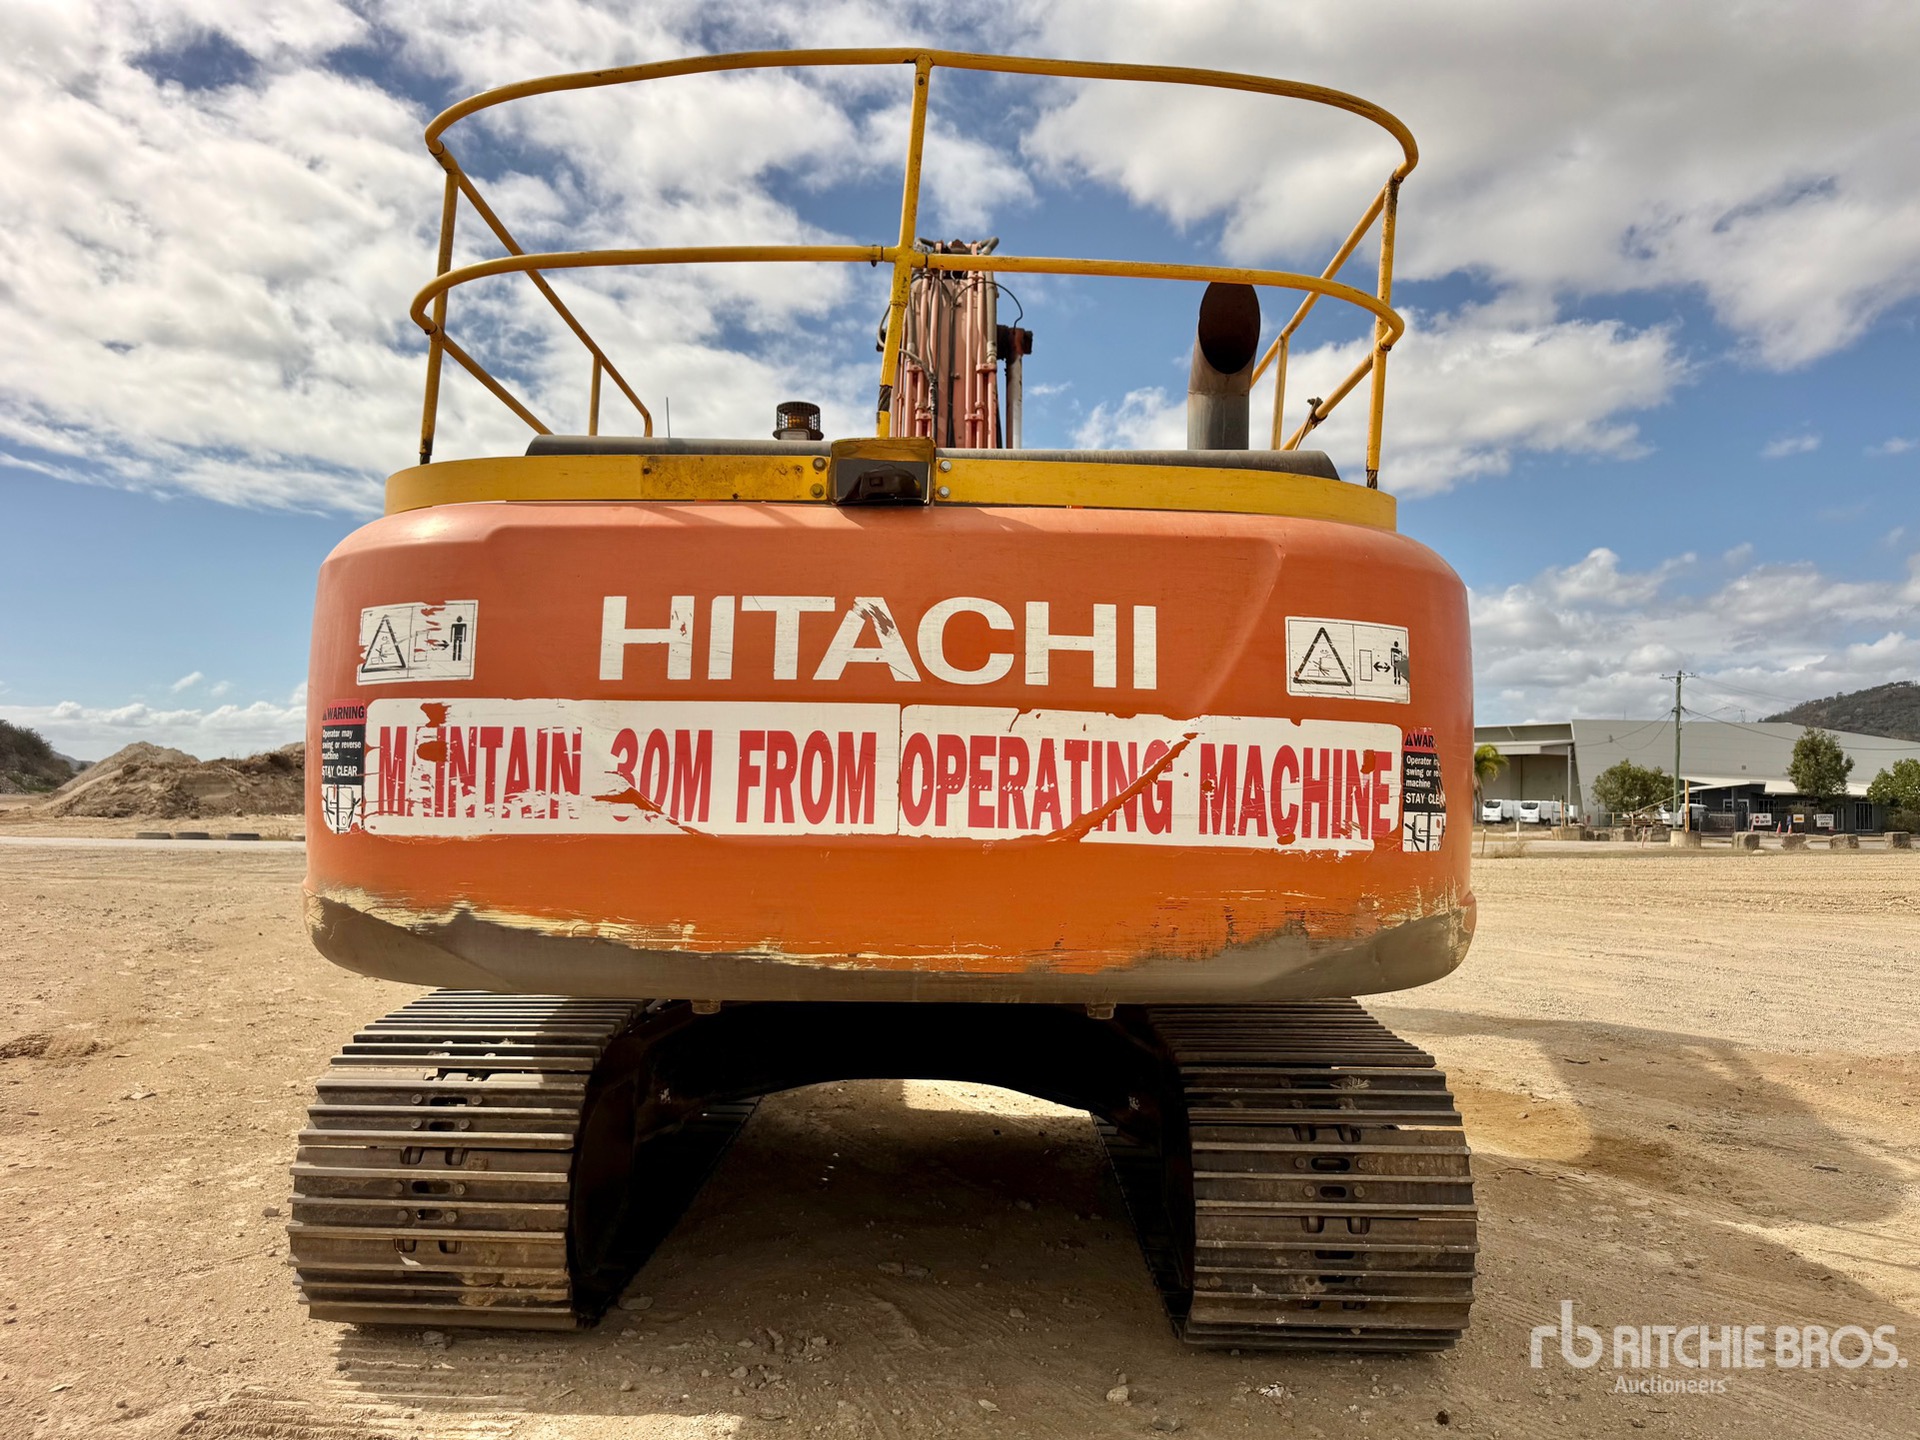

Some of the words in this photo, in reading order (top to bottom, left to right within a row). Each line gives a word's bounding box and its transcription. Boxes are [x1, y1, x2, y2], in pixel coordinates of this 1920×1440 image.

[599, 596, 1157, 690] HITACHI
[327, 706, 365, 720] WARNING
[322, 729, 341, 739] Operator
[341, 730, 353, 739] may
[341, 741, 362, 749] reverse
[1406, 755, 1432, 766] Operator
[322, 765, 334, 777] STAY
[336, 765, 358, 776] CLEAR
[1405, 767, 1424, 778] swing
[1425, 769, 1432, 777] or
[610, 728, 713, 823] 30M
[735, 730, 877, 825] FROM
[901, 732, 1173, 834] OPERATING
[1199, 743, 1393, 841] MACHINE
[1405, 779, 1431, 788] machine
[1405, 793, 1425, 804] STAY
